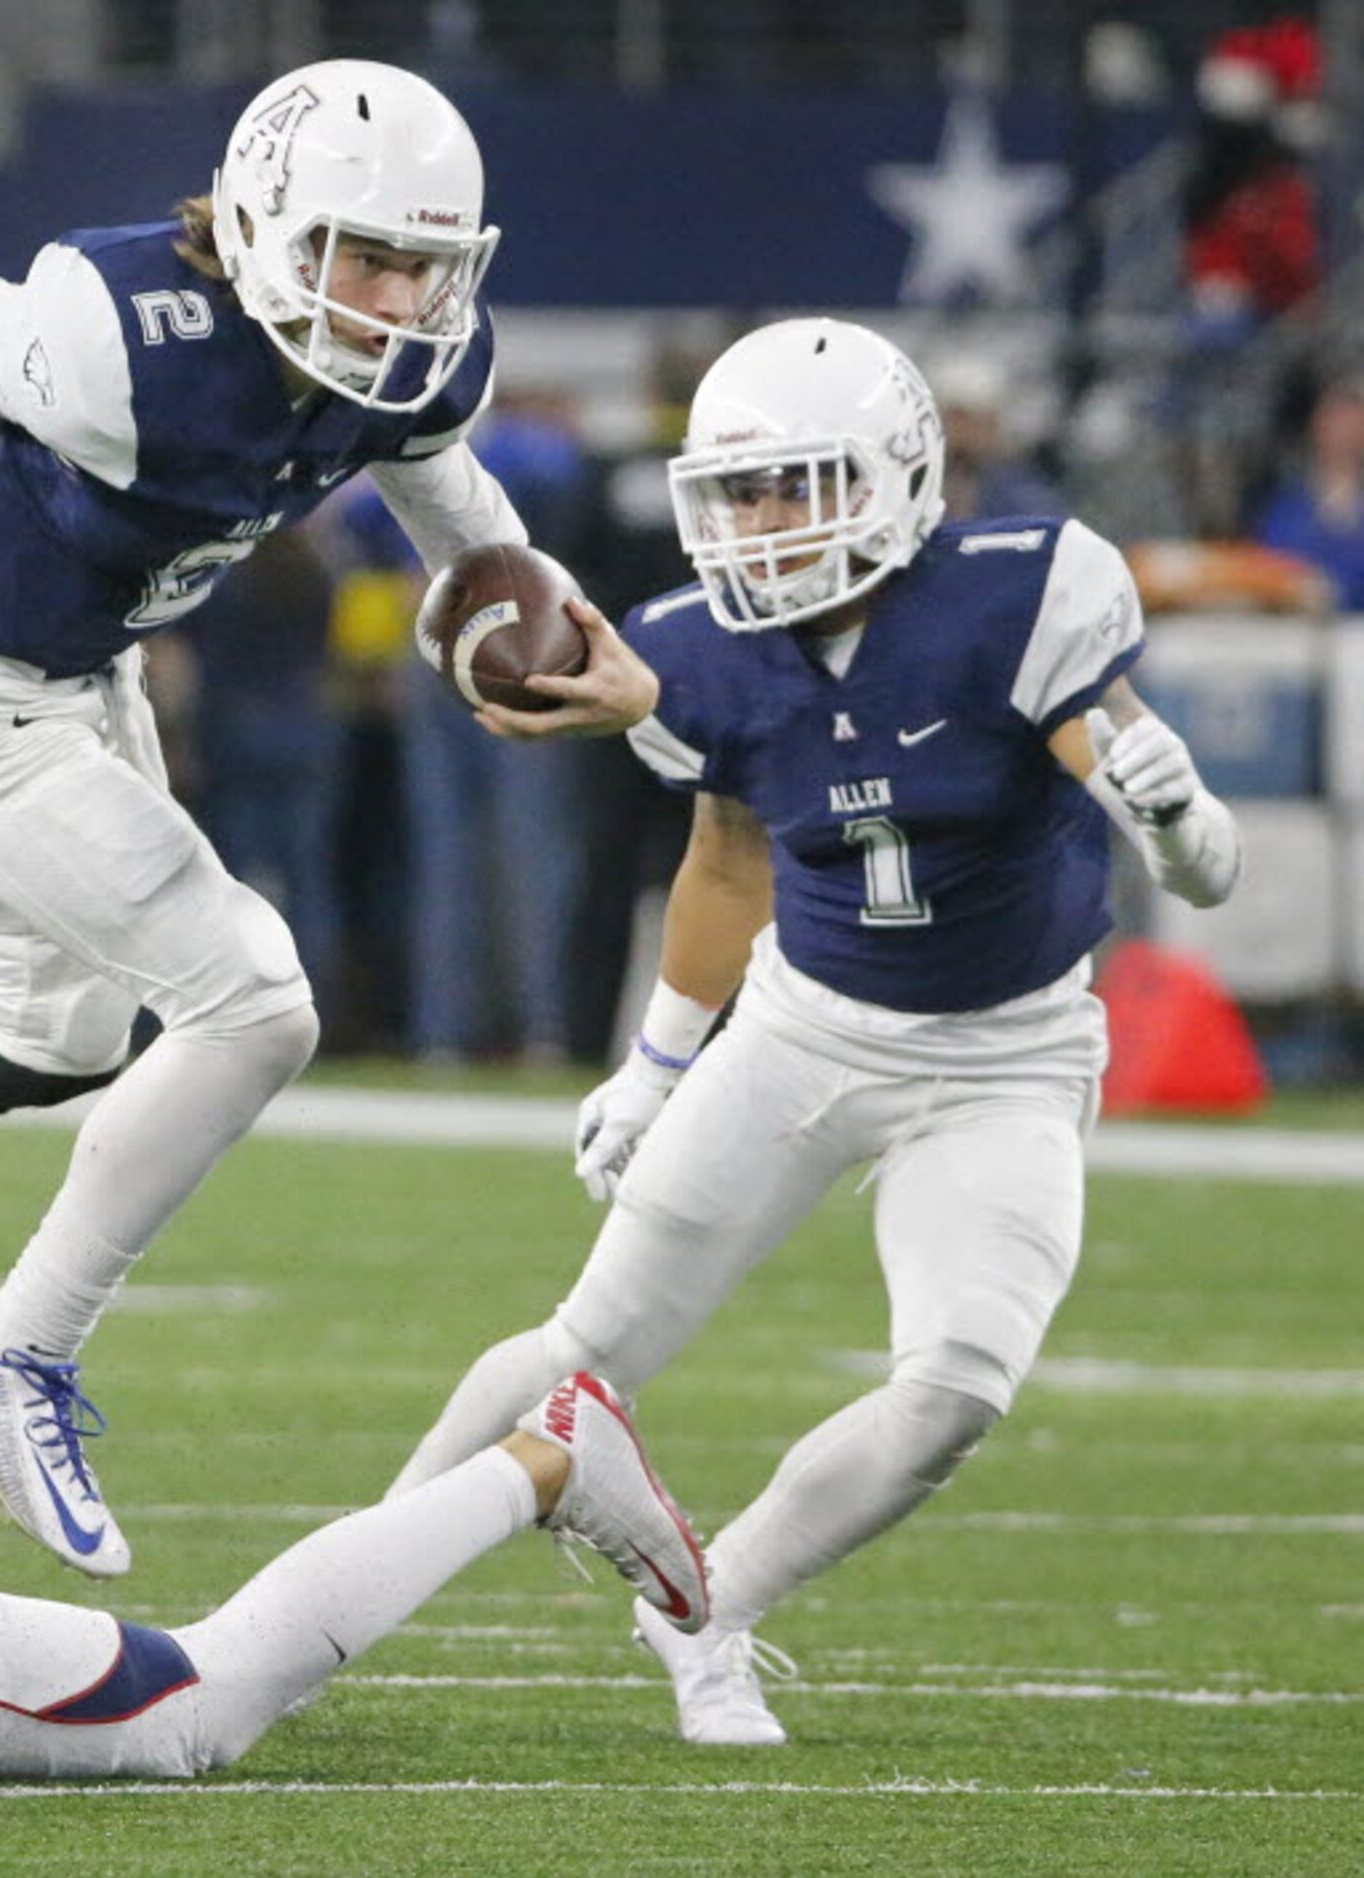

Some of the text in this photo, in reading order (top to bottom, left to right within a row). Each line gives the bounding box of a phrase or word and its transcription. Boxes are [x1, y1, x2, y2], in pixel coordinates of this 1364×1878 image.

[130, 289, 215, 346] 2
[959, 530, 1048, 555] 1
[123, 537, 258, 629] 2
[833, 711, 860, 742] A
[828, 777, 893, 814] ALLEN
[842, 815, 933, 927] 1
